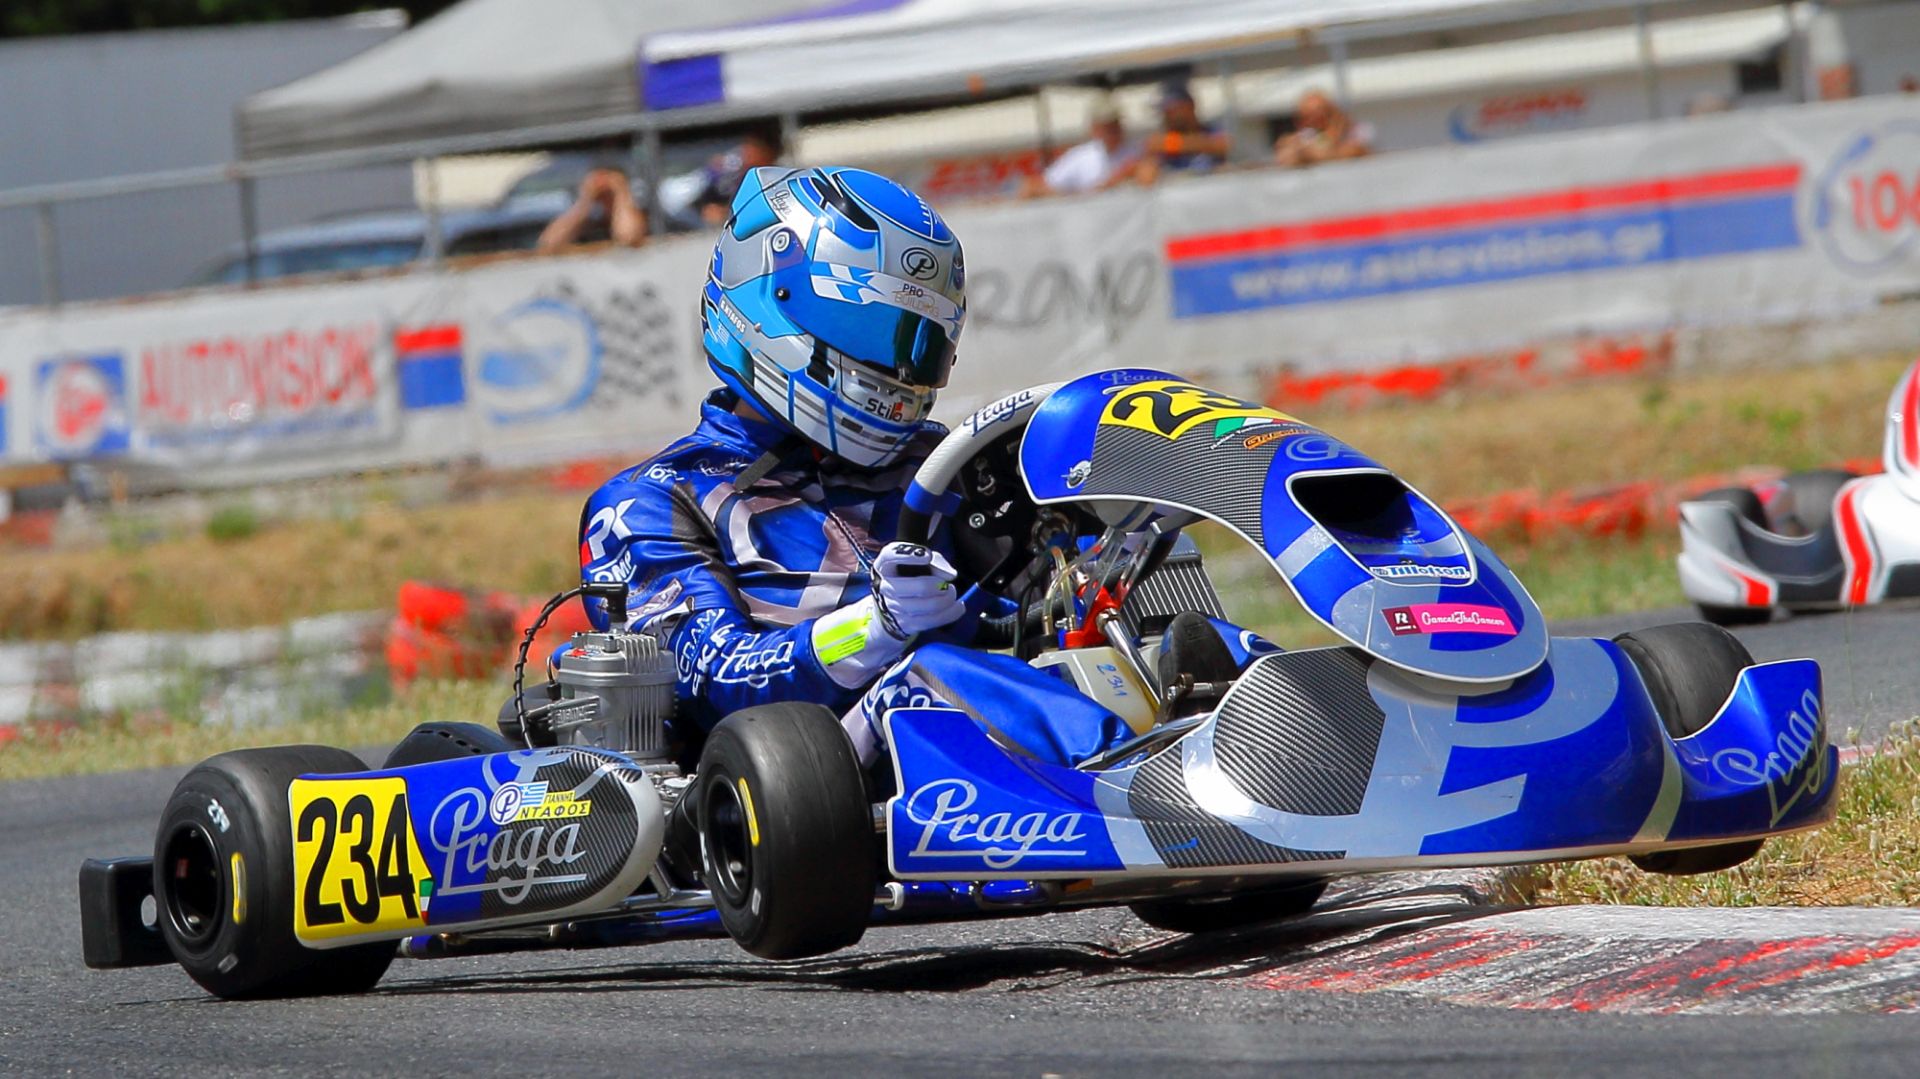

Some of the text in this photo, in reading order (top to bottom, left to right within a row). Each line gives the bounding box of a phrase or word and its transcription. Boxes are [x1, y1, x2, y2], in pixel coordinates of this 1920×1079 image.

[902, 283, 924, 298] PRO
[864, 398, 903, 422] Stilo
[297, 793, 420, 927] 234
[430, 787, 588, 905] Praga
[906, 778, 1087, 869] Praga
